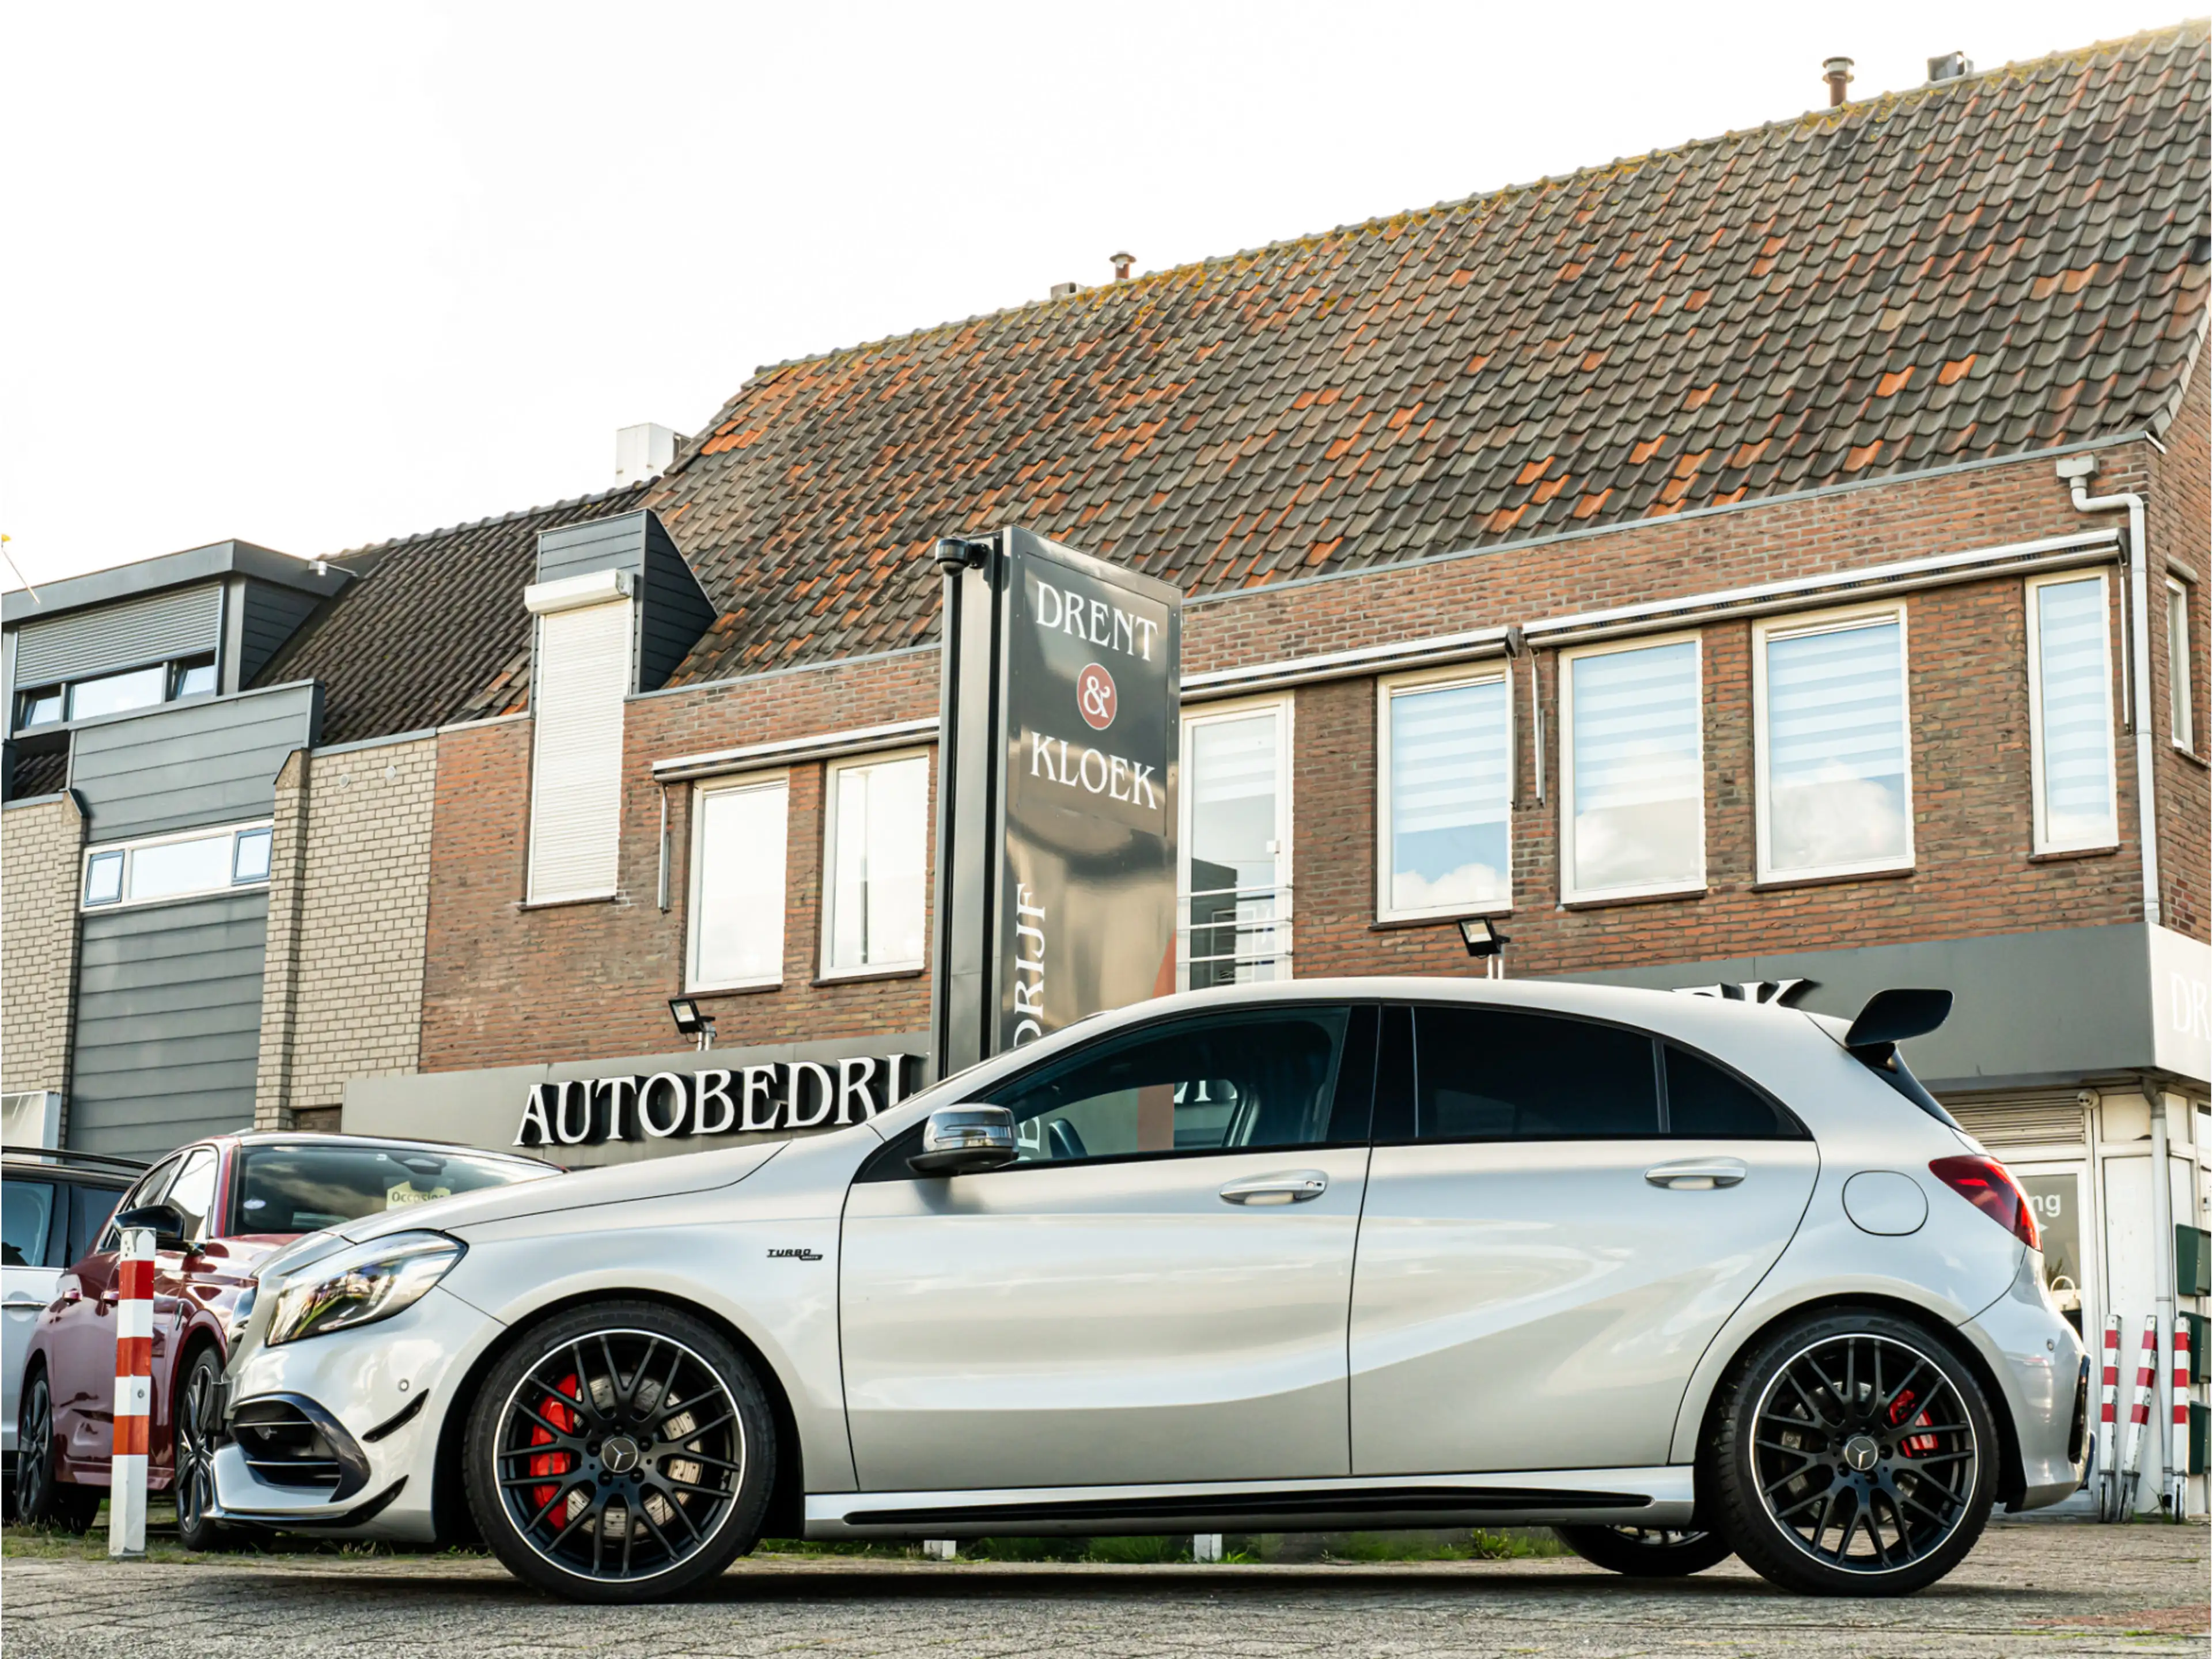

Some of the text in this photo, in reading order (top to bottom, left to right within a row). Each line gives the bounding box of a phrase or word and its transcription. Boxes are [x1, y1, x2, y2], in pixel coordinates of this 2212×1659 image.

[1036, 581, 1158, 661] DRENT
[1084, 676, 1111, 718] &
[1030, 731, 1157, 810] KLOEK
[512, 1052, 930, 1146] AUTOBEDRI
